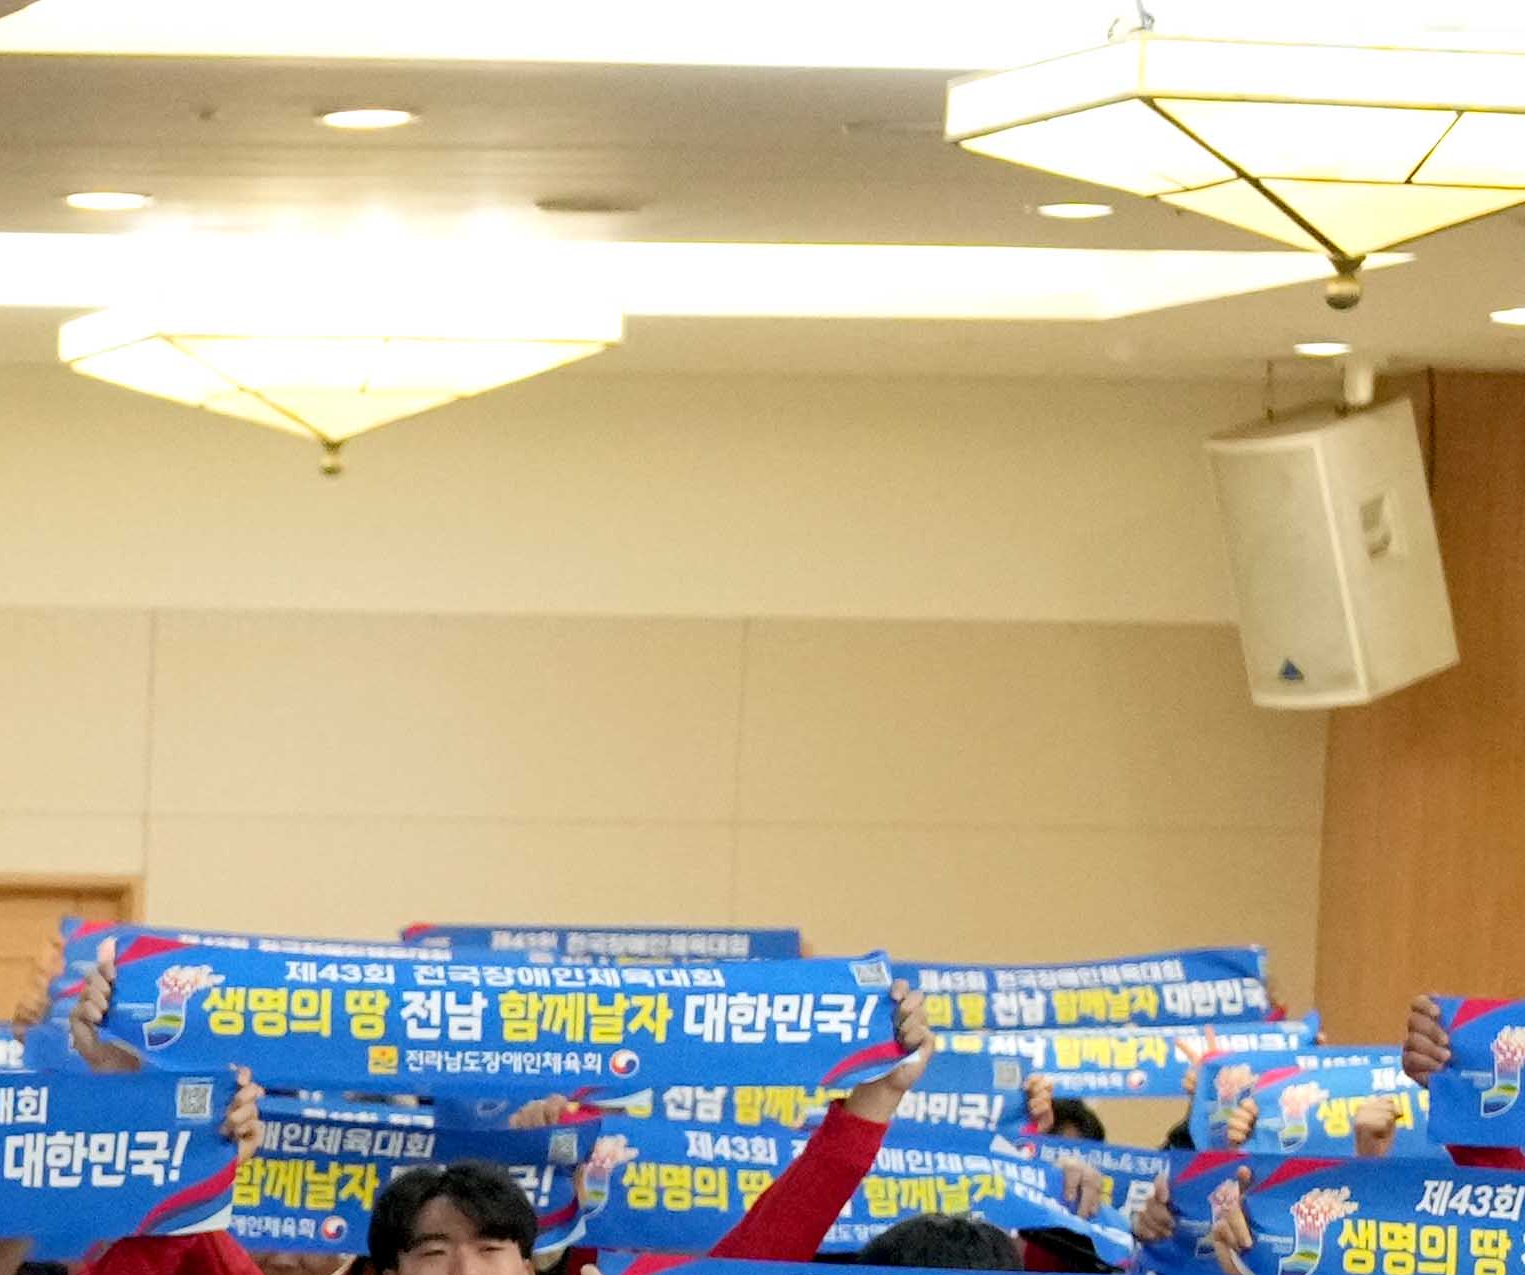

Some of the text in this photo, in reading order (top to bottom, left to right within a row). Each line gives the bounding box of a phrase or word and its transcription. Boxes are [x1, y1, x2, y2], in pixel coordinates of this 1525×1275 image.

[286, 961, 725, 987] 제43회 전국장애인체육대회
[196, 981, 878, 1043] 생명의 땅 전남 함께날자 대한민국!
[406, 1050, 601, 1074] 전라남도장애인체육회
[4, 1131, 190, 1187] 대한민국!
